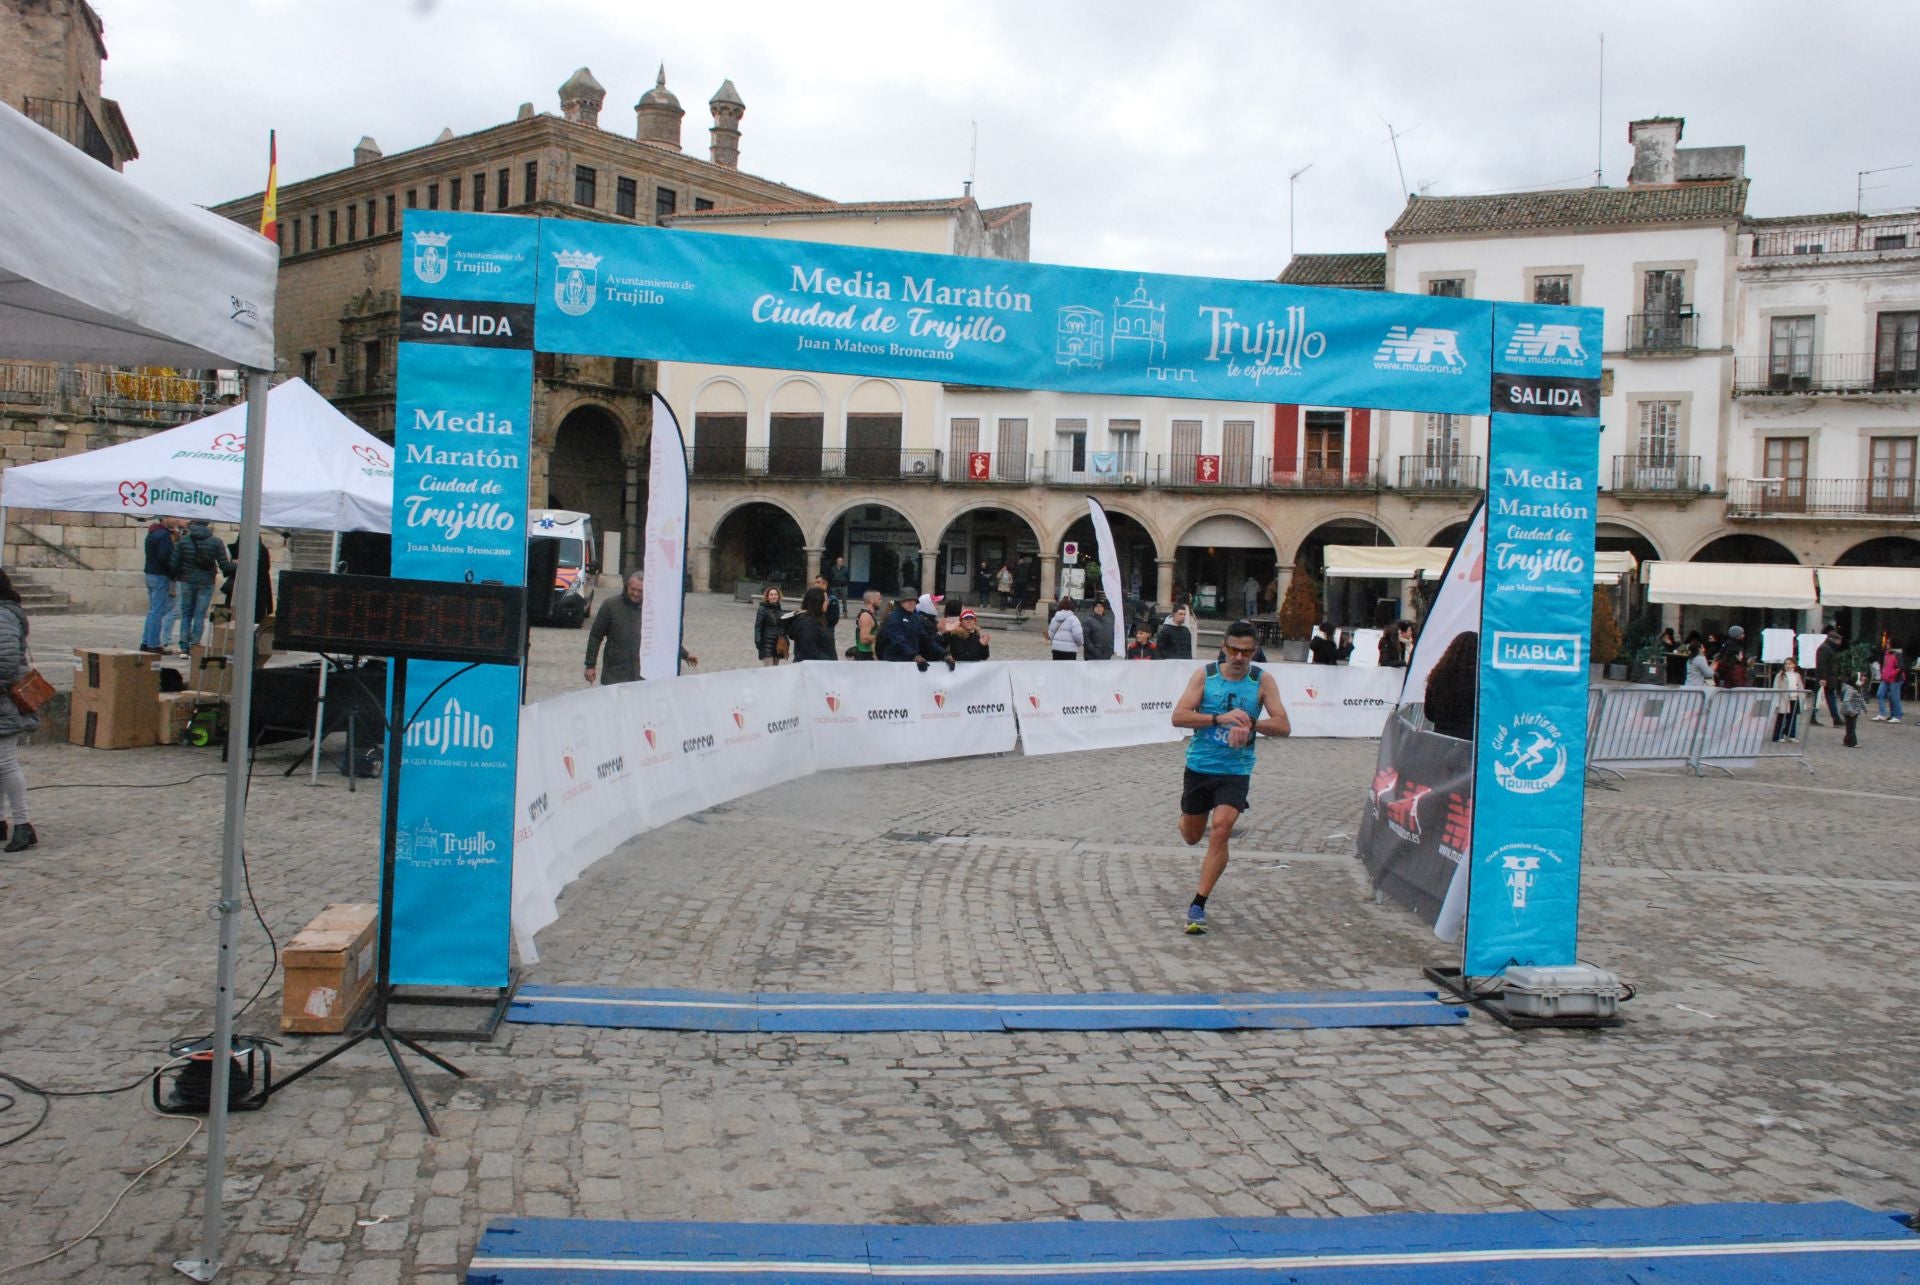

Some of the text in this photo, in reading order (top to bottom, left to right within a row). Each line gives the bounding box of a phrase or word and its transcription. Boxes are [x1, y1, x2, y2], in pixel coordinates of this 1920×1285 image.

[454, 260, 501, 275] Trujillo
[456, 250, 526, 264] Ayuntamiento de
[605, 274, 695, 290] Ayuntamiento de
[790, 265, 1032, 312] Media Maratón
[605, 286, 664, 306] Trujillo
[421, 311, 513, 337] SALIDA
[751, 294, 1007, 349] Ciudad de Trujillo
[1198, 304, 1327, 369] Trujillo
[797, 335, 955, 361] Juan Mateos Broncano
[1227, 357, 1242, 376] te
[1373, 360, 1464, 375] www.musicrun.es
[1504, 353, 1585, 368] www.musicrun.es
[1510, 385, 1583, 407] SALIDA
[413, 409, 515, 436] Media
[172, 450, 244, 463] primaflo
[405, 444, 520, 470] Maratón
[419, 473, 503, 496] Ciudad de
[1503, 467, 1583, 490] Media
[150, 488, 219, 507] primaflor
[1496, 497, 1589, 520] Maratón
[404, 494, 515, 541] Trujillo
[1507, 524, 1573, 542] Ciudad de
[407, 542, 512, 556] Juan Mateos Broncano
[1495, 542, 1585, 581] Trujillo
[1497, 582, 1515, 592] Juan
[1516, 583, 1545, 593] Mateos
[1504, 644, 1568, 662] HABLA
[1492, 712, 1562, 750] Club Atletismo
[440, 831, 496, 856] Trujillo
